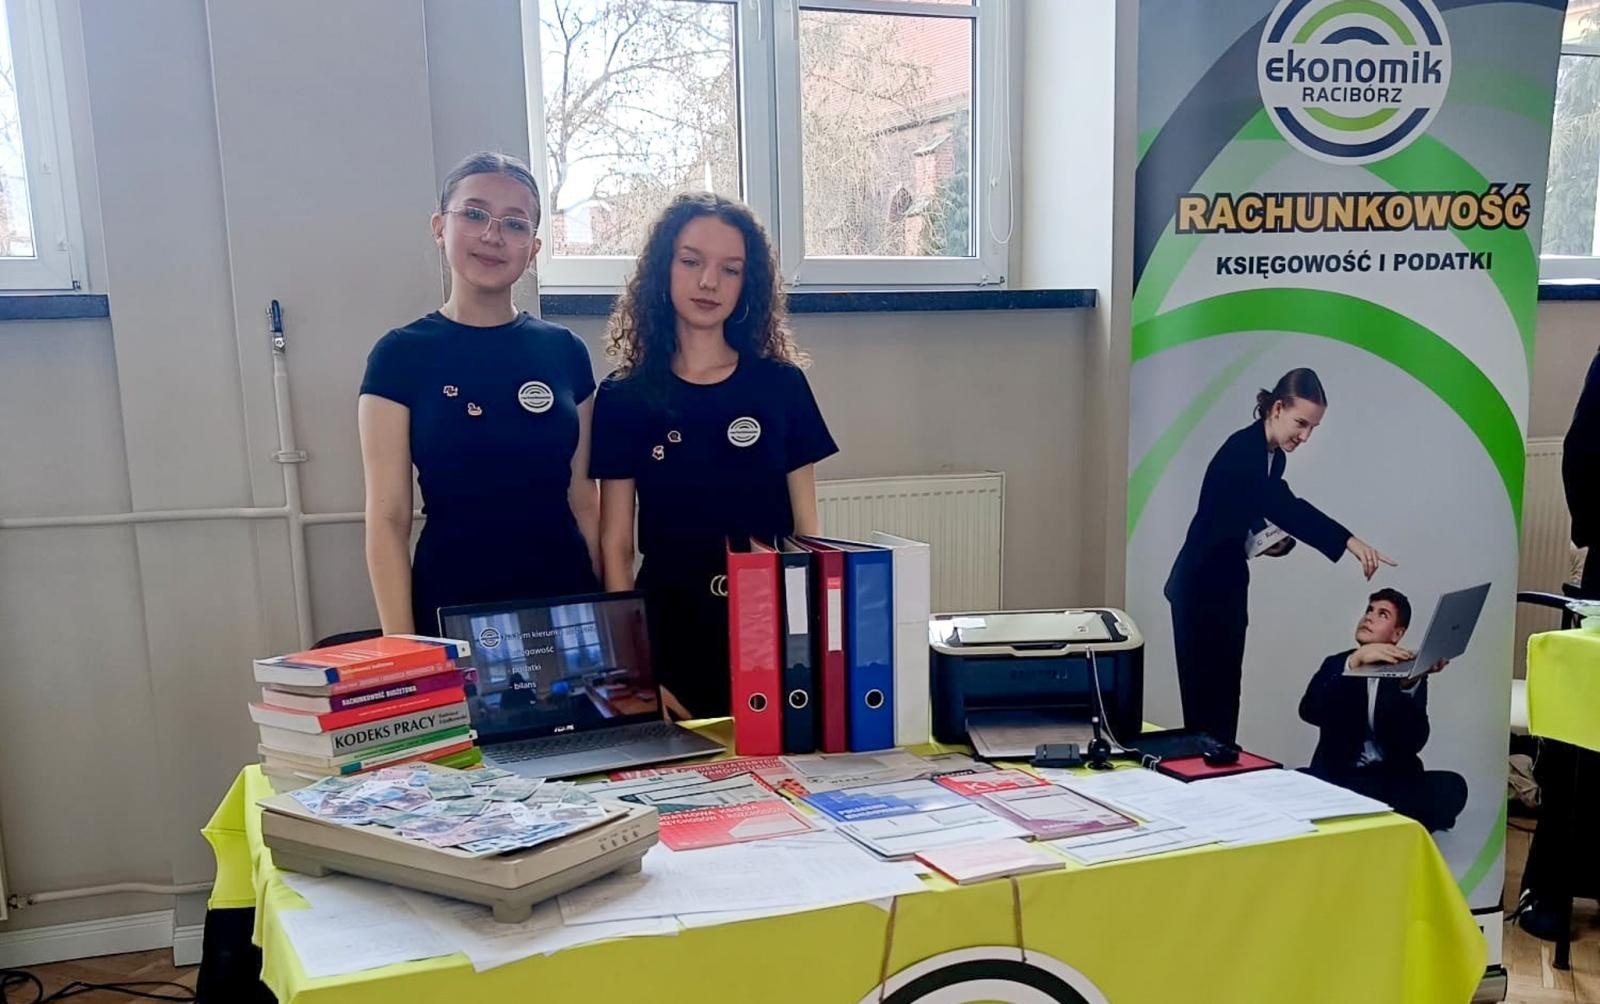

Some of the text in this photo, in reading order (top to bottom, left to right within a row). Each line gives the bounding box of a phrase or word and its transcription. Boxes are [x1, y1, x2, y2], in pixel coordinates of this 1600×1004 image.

[1301, 85, 1403, 104] RACIBÓRZ
[1175, 183, 1531, 234] RACHUNKOWOŚĆ
[1215, 250, 1493, 279] KSIĘGOWOŚĆ I PODATKI
[335, 726, 390, 749] KODEKS
[393, 715, 436, 735] PRACY
